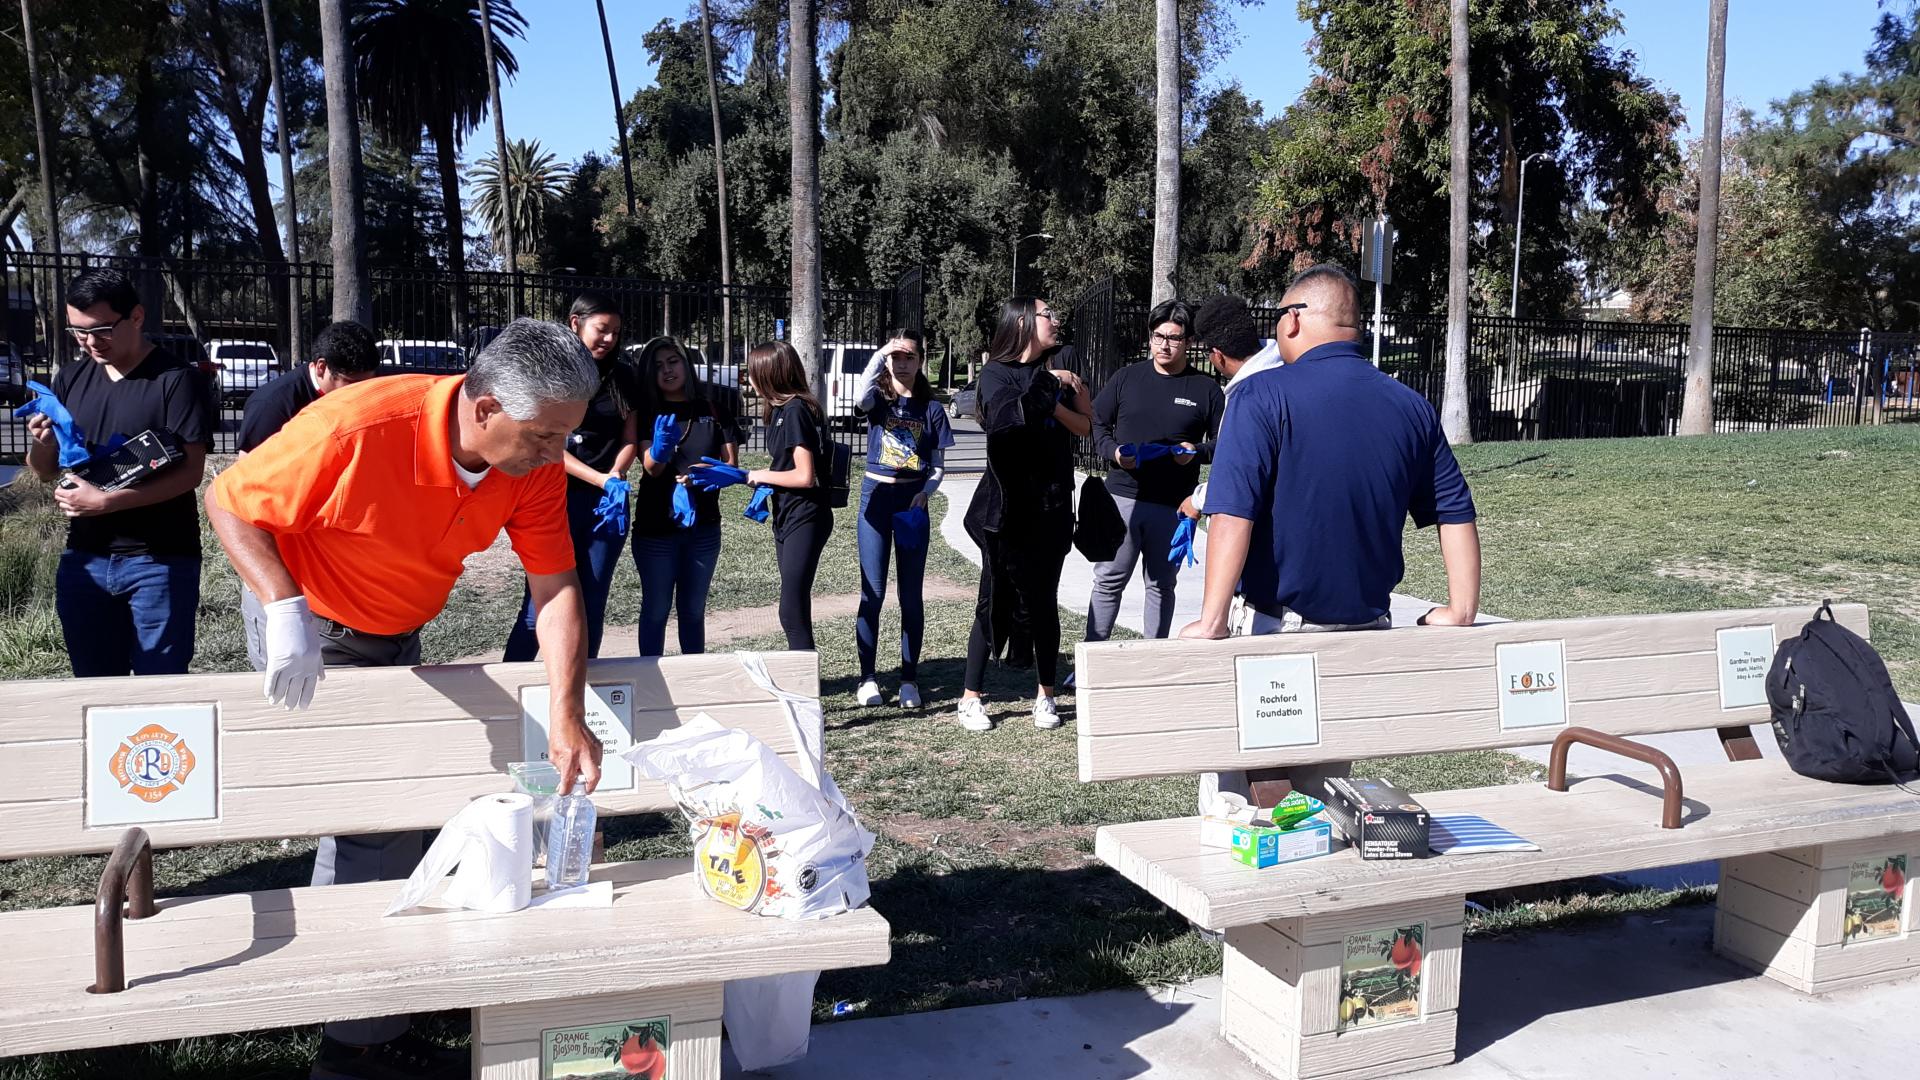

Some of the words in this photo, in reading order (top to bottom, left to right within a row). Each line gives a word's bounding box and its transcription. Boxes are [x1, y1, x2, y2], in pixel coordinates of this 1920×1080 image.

[1270, 681, 1285, 690] The
[1260, 694, 1297, 704] Rochford
[1256, 708, 1303, 718] Foundation
[709, 855, 746, 884] TAE
[553, 1043, 581, 1061] Blossom
[582, 1042, 605, 1057] Brand
